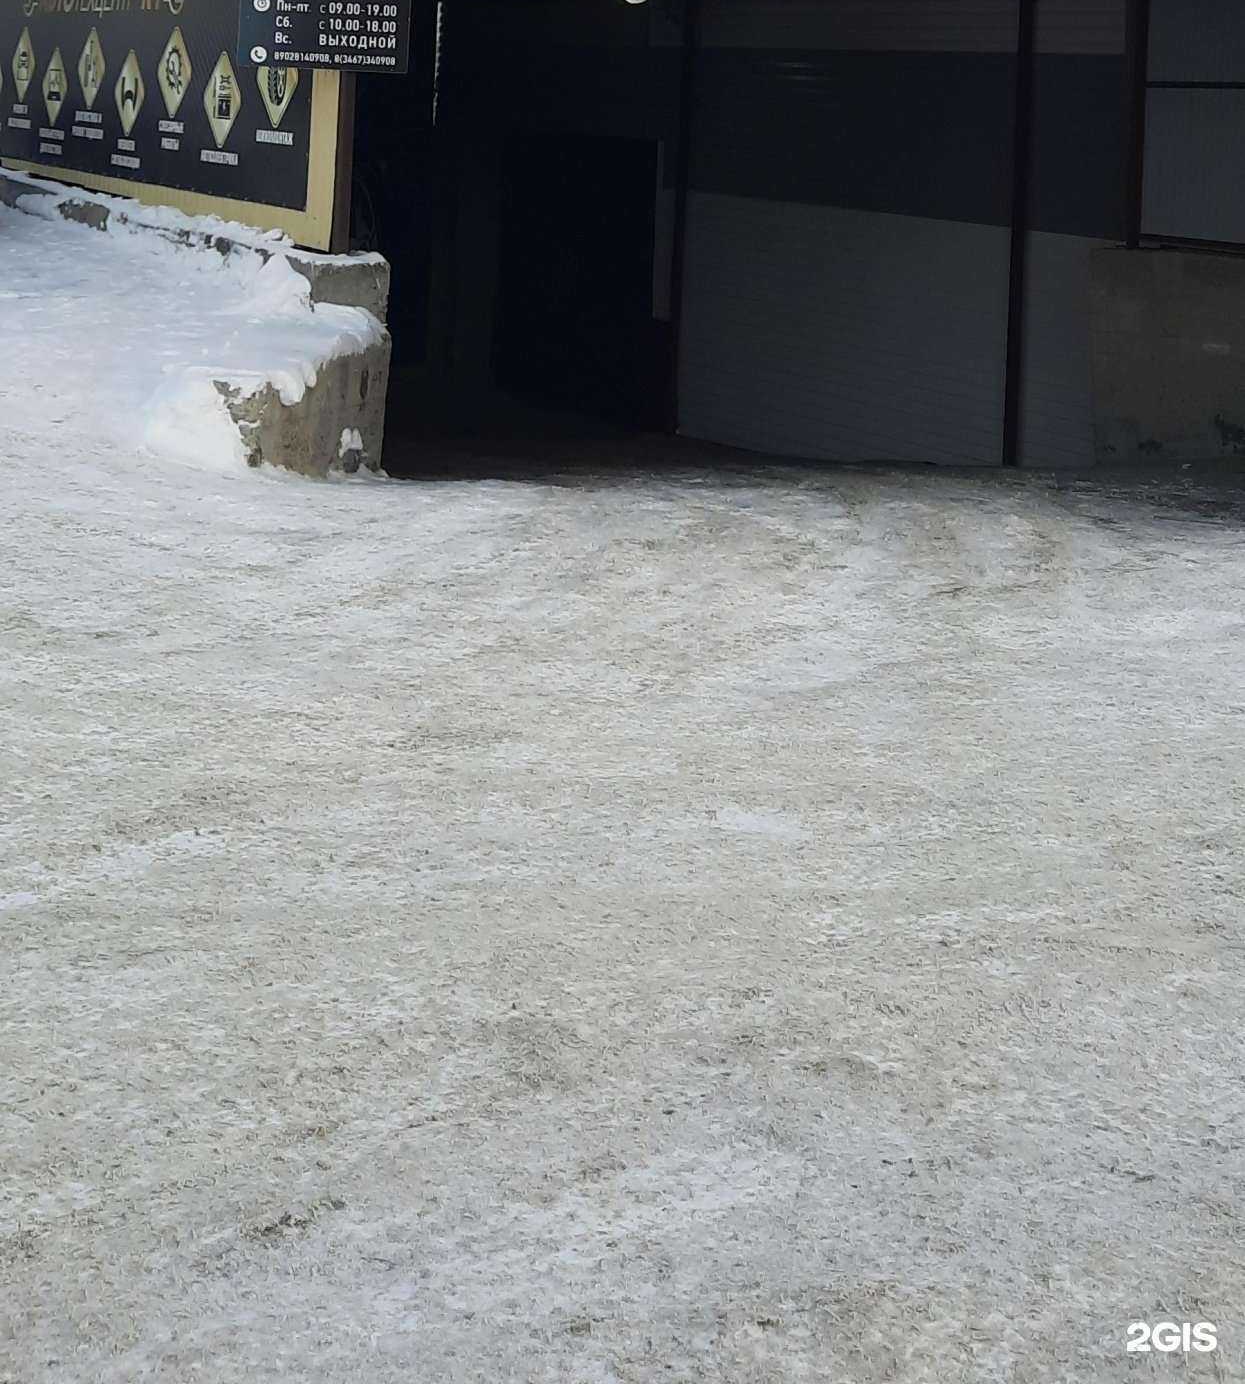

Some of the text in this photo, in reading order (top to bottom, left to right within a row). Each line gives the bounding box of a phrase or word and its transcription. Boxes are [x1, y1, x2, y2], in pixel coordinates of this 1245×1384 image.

[328, 2, 397, 17] 09.00-19.00
[275, 16, 293, 28] Сб.
[329, 19, 396, 33] 10.00-18.00
[274, 32, 396, 49] Вс. ВЫХОДНОЙ
